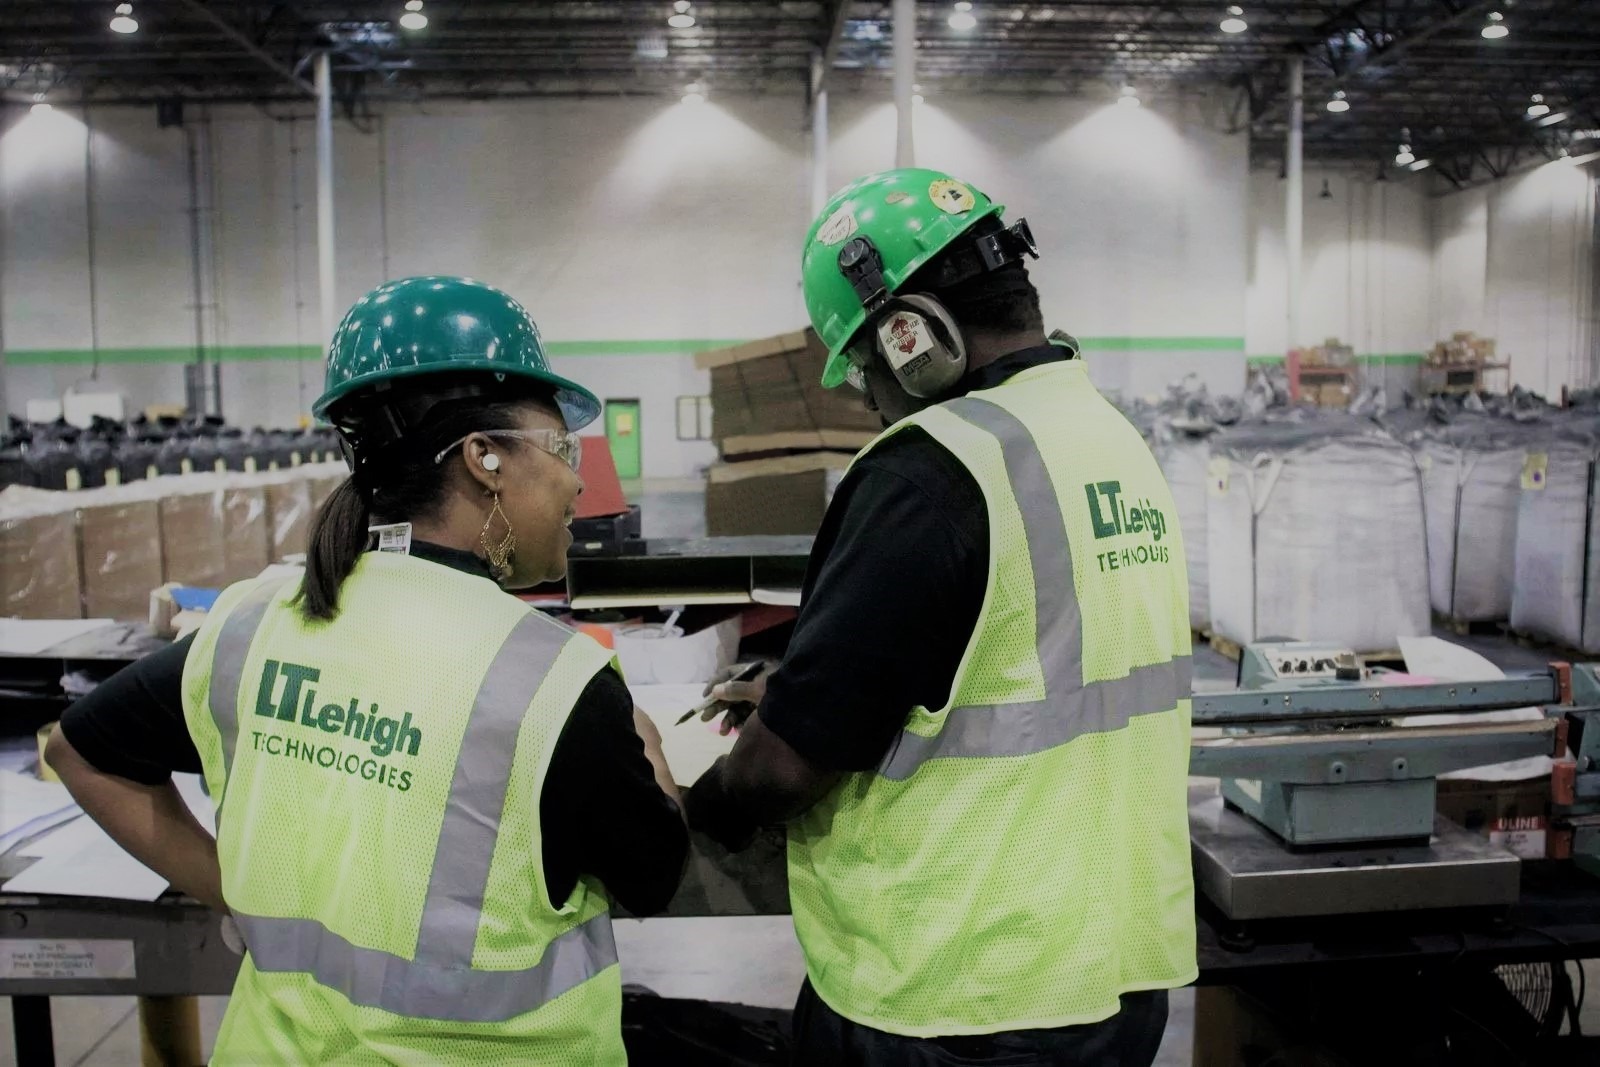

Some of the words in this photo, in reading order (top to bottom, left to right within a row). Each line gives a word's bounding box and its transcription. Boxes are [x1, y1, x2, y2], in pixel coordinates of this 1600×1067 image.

[903, 354, 930, 375] MSA
[301, 689, 422, 758] Lehigh
[1498, 816, 1539, 830] ULINE
